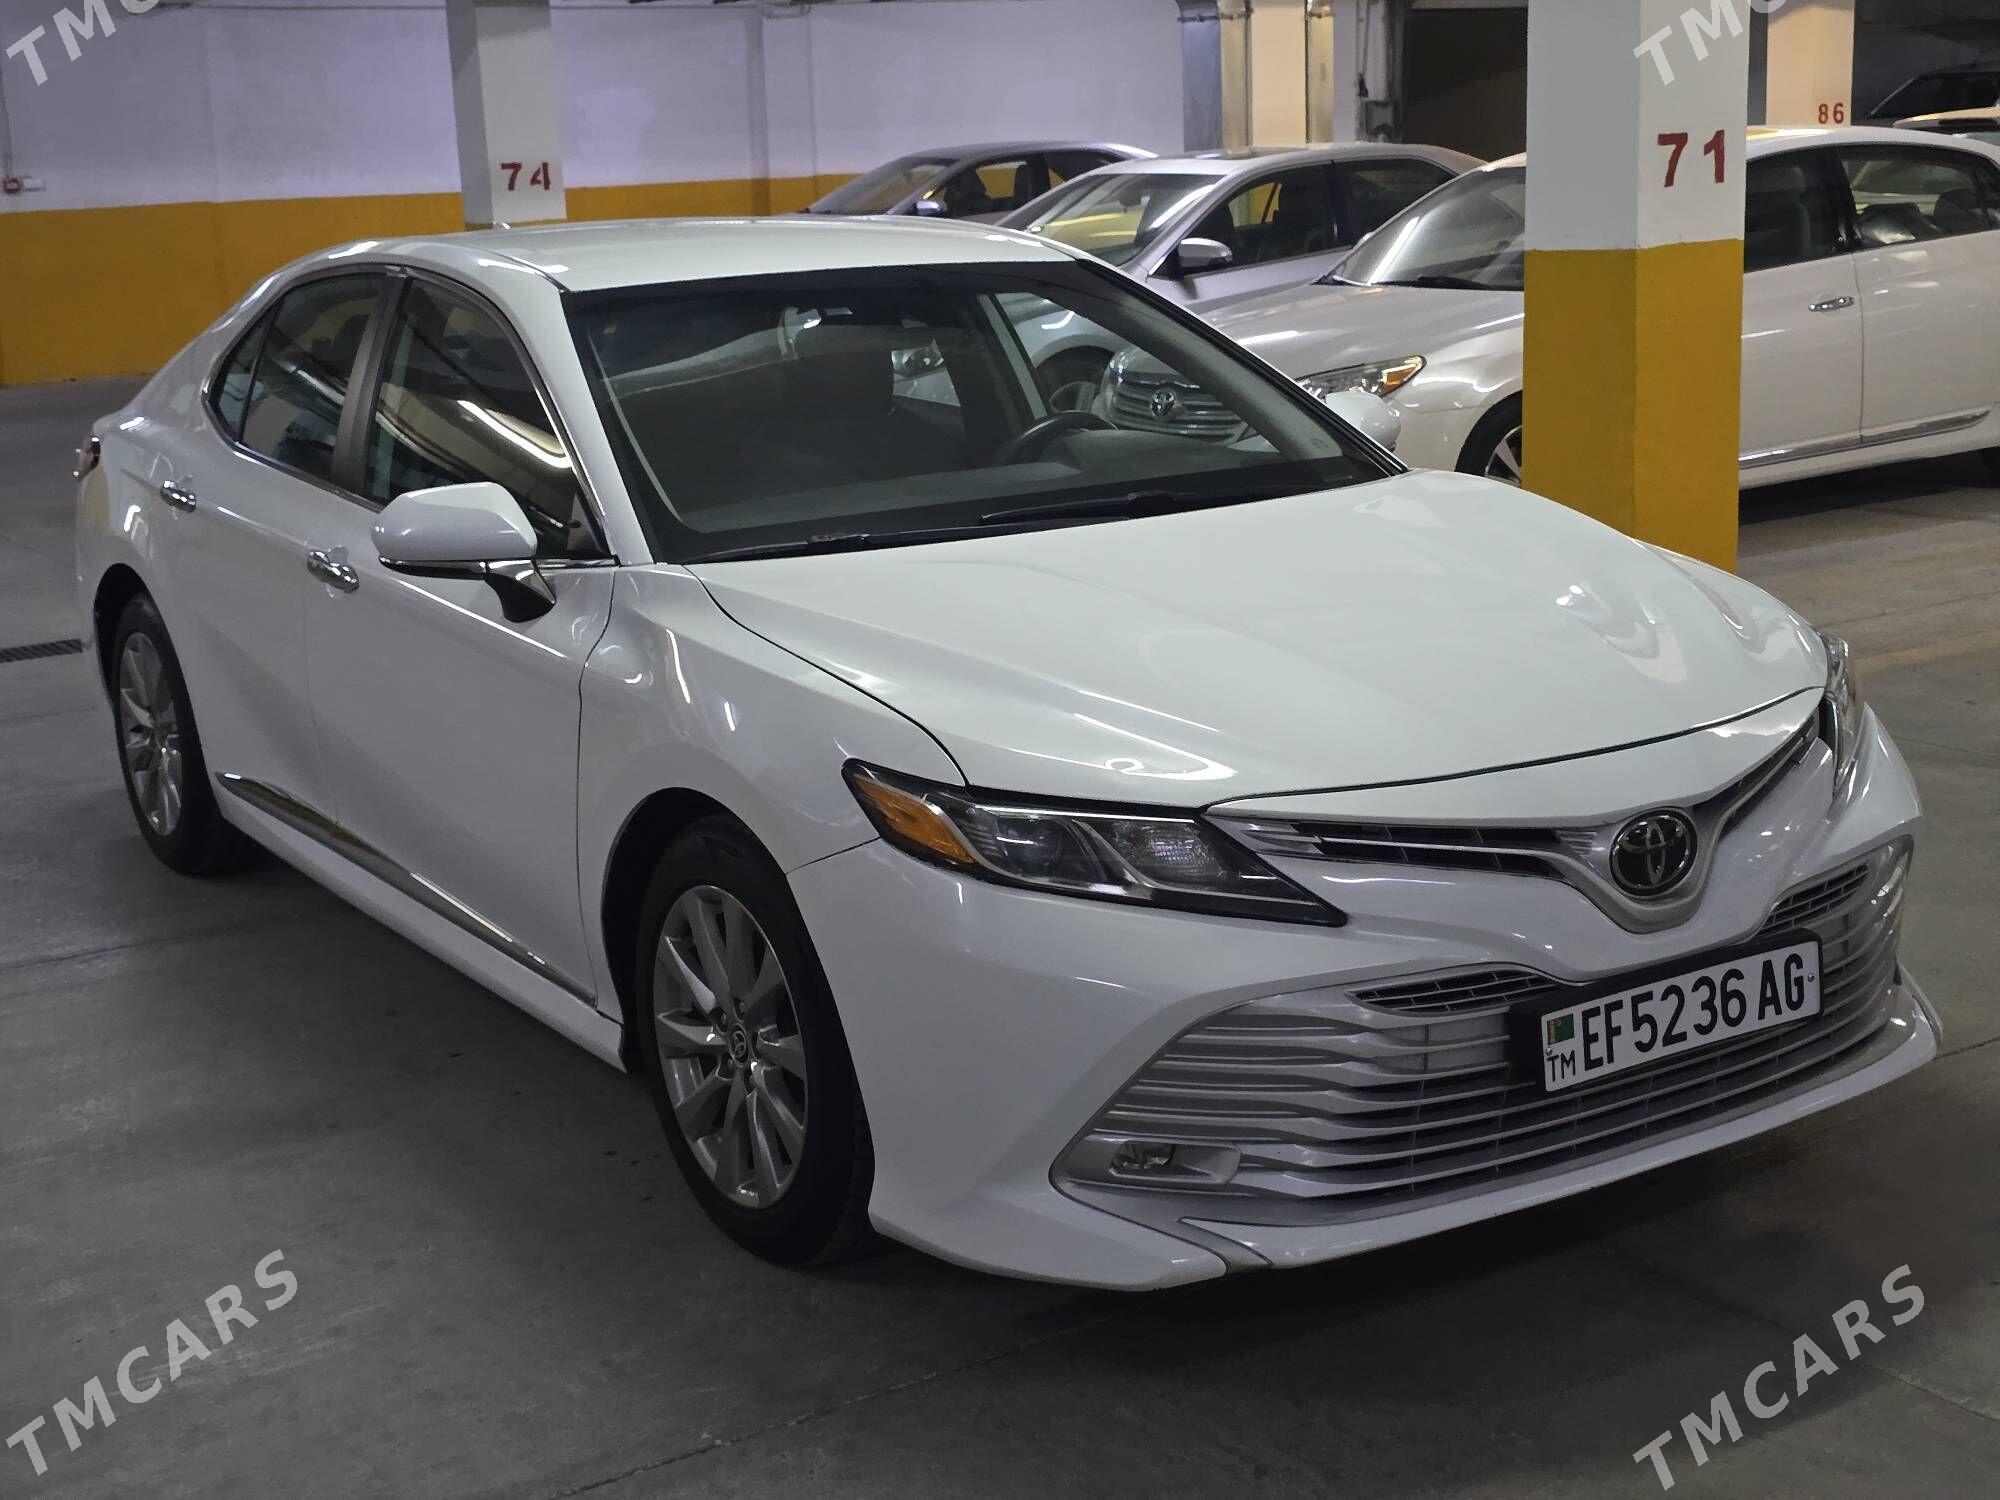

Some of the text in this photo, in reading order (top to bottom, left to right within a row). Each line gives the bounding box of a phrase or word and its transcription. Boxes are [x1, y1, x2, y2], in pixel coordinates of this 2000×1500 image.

[1818, 103, 1844, 124] 86
[1657, 130, 1725, 188] 71
[501, 162, 550, 191] 74
[1758, 953, 1805, 1020] AG
[1547, 1050, 1576, 1081] TM
